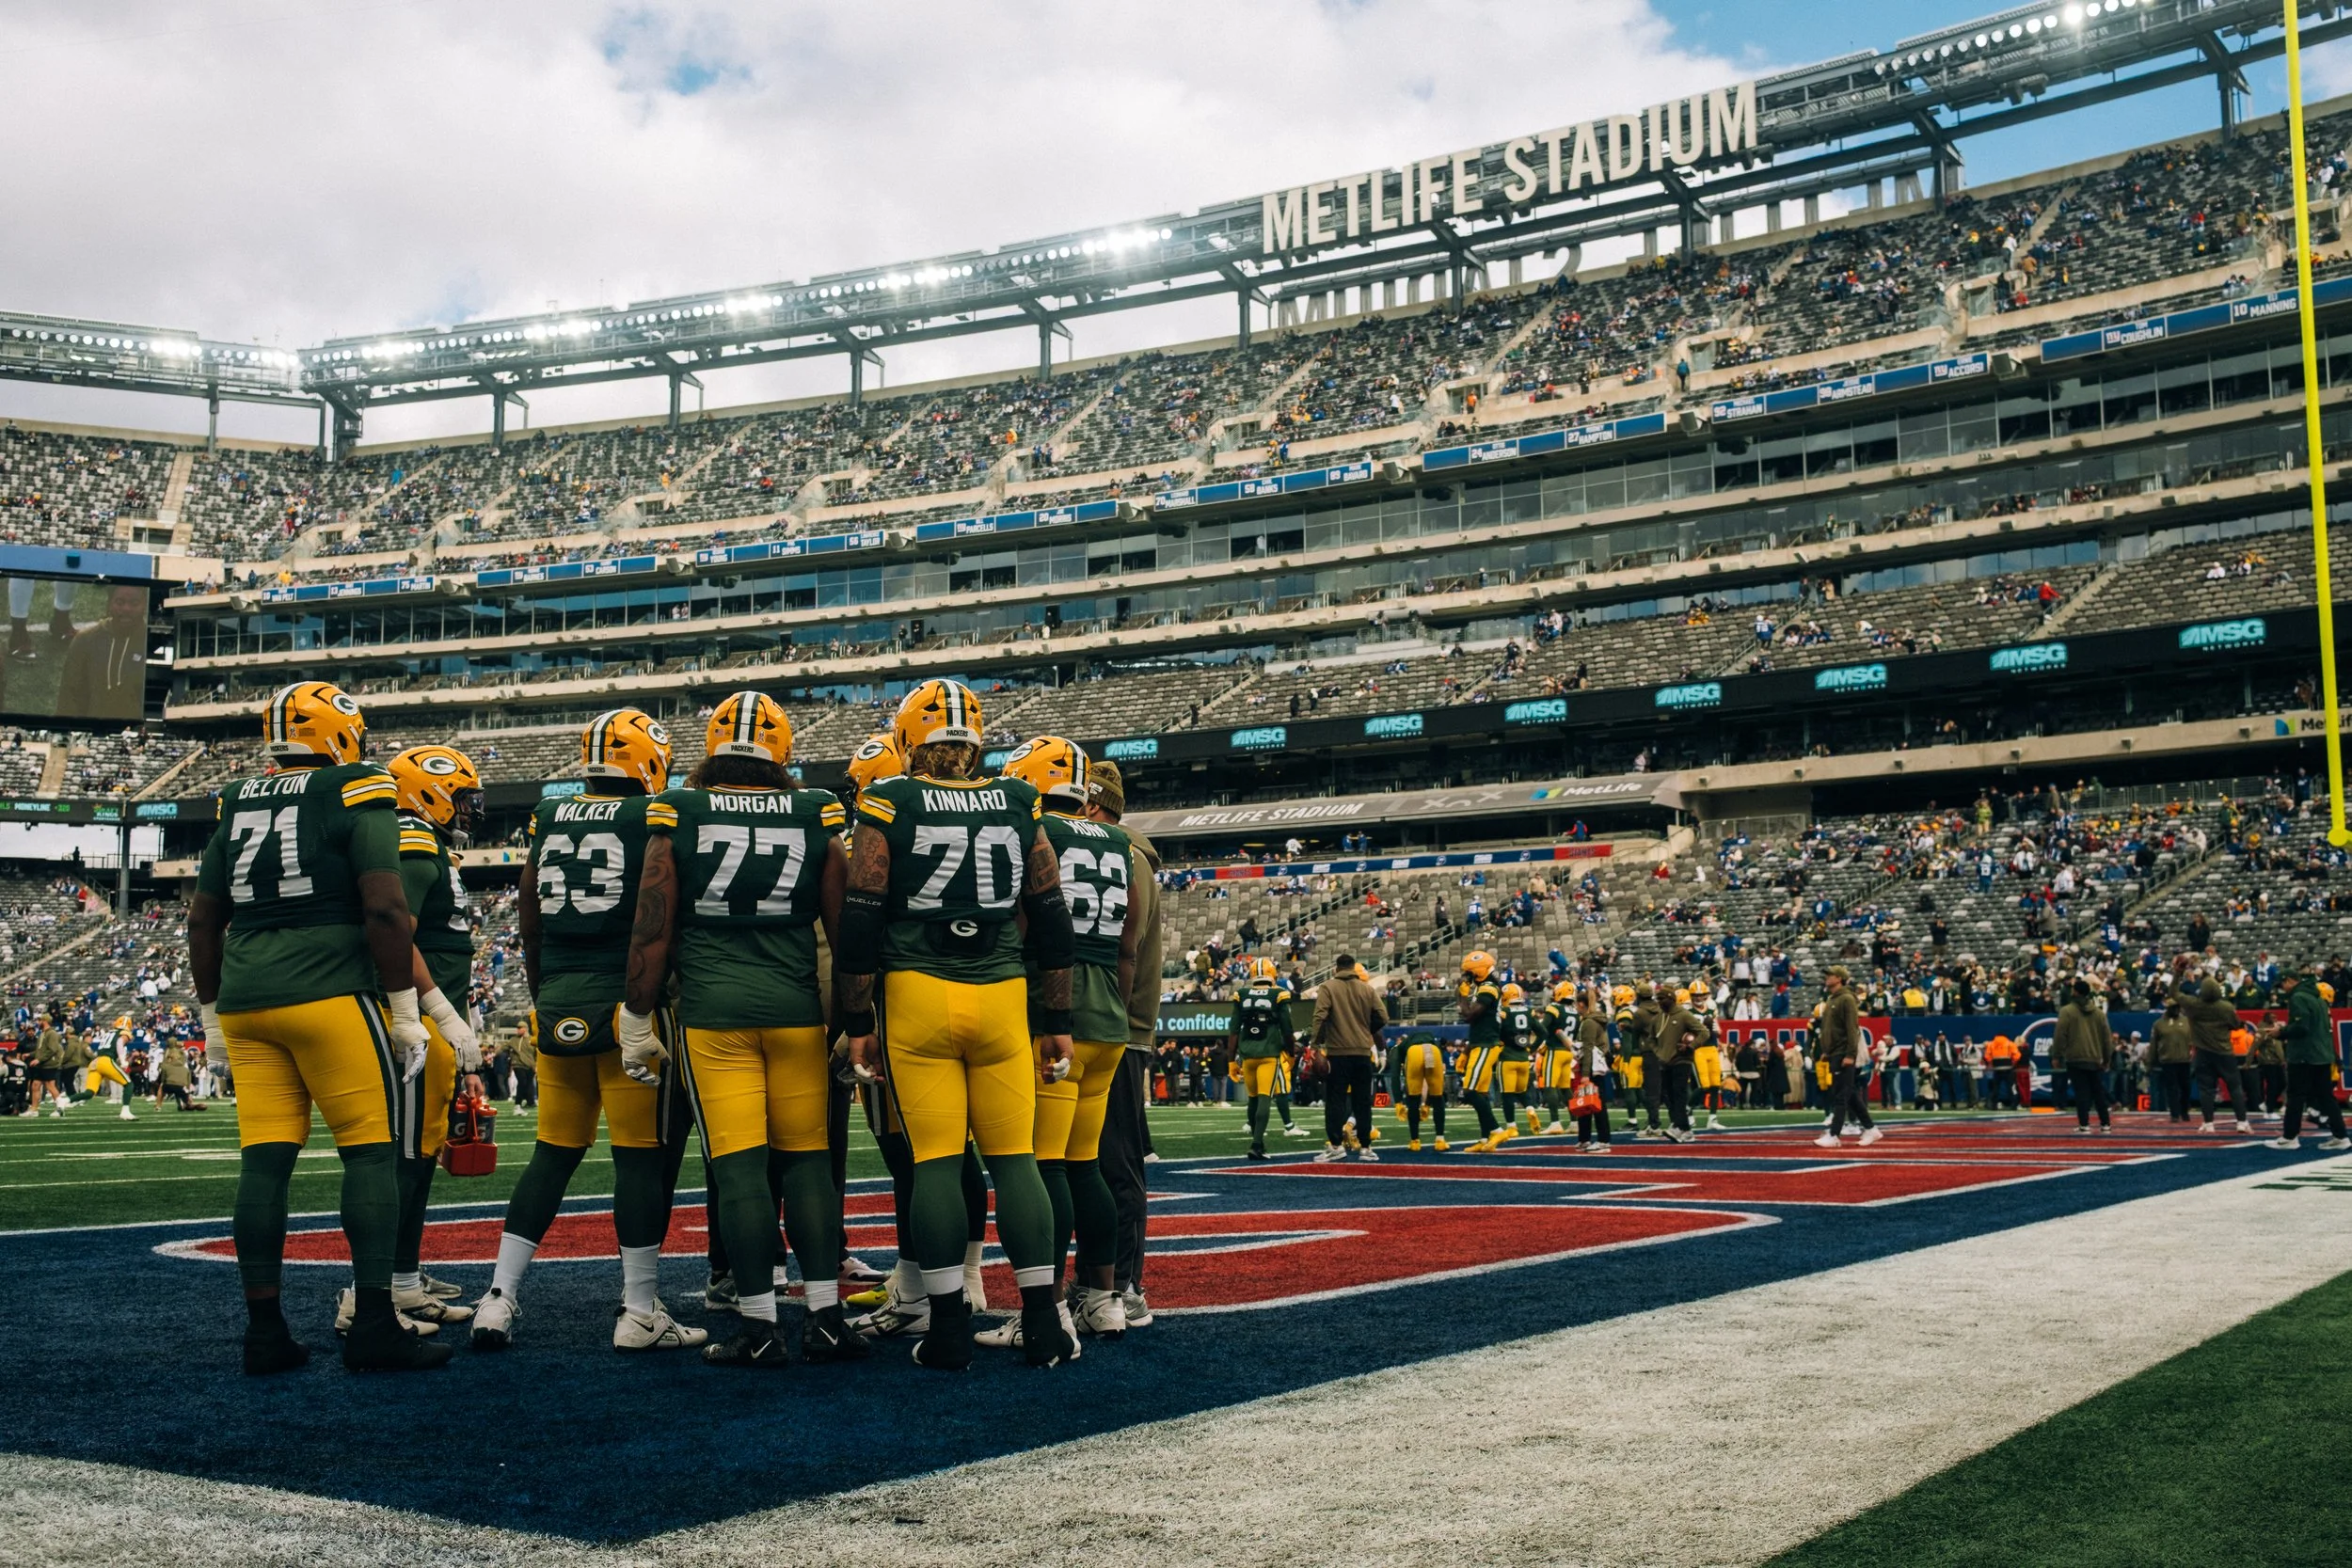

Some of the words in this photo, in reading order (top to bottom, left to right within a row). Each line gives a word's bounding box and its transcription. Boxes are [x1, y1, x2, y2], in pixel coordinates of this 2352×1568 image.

[1263, 148, 1484, 254] METLIFE
[1504, 80, 1757, 203] STADIUM
[2233, 303, 2248, 317] 10
[2249, 297, 2296, 318] MANNING
[2121, 325, 2163, 345] COUGHLIN
[1947, 361, 1984, 378] ACCORSI
[1832, 383, 1872, 400] ARMSTEAD
[1713, 405, 1726, 418] 92
[1726, 404, 1763, 420] STRAHAN
[1567, 432, 1580, 443] 27
[1579, 430, 1613, 445] HAMPTON
[1470, 448, 1483, 459] 24
[1482, 447, 1517, 462] ANDERSON
[1256, 483, 1279, 496] BANKS
[1155, 496, 1166, 507] 70
[1165, 496, 1196, 509] MARSHALL
[1039, 513, 1050, 522] 20
[966, 522, 994, 535] PARCELLS
[772, 545, 780, 553] 11
[860, 537, 881, 548] TAYLOR
[410, 581, 431, 592] MARTIN
[282, 593, 294, 601] PELT
[2204, 618, 2265, 644] MSG
[2202, 640, 2265, 652] NETWORKS
[2008, 643, 2068, 669] MSG
[1834, 663, 1886, 688] MSG
[1672, 683, 1722, 705] MSG
[1520, 699, 1567, 720] MSG
[1673, 701, 1721, 710] NETWORKS
[1379, 713, 1423, 734] MSG
[1520, 717, 1567, 725] NETWORKS
[946, 729, 969, 737] PACKERS
[1244, 726, 1286, 745] MSG
[730, 745, 755, 753] PACKERS
[1117, 738, 1158, 756] MSG
[238, 772, 312, 800] BELTON
[552, 782, 585, 796] MSG
[1563, 782, 1644, 798] MetLife
[14, 802, 52, 812] MONEYLINE
[708, 794, 792, 815] MORGAN
[922, 788, 1008, 813] KINNARD
[145, 802, 177, 816] MSG
[554, 801, 622, 823] WALKER
[1178, 810, 1265, 828] METLIFE
[1266, 802, 1365, 821] STADIUM
[230, 805, 314, 903] 71
[537, 832, 625, 914] 63
[694, 824, 806, 916] 77
[907, 826, 1024, 910] 70
[849, 896, 882, 907] MUELLER
[1515, 1014, 1528, 1029] 0
[1375, 1095, 1388, 1106] 20
